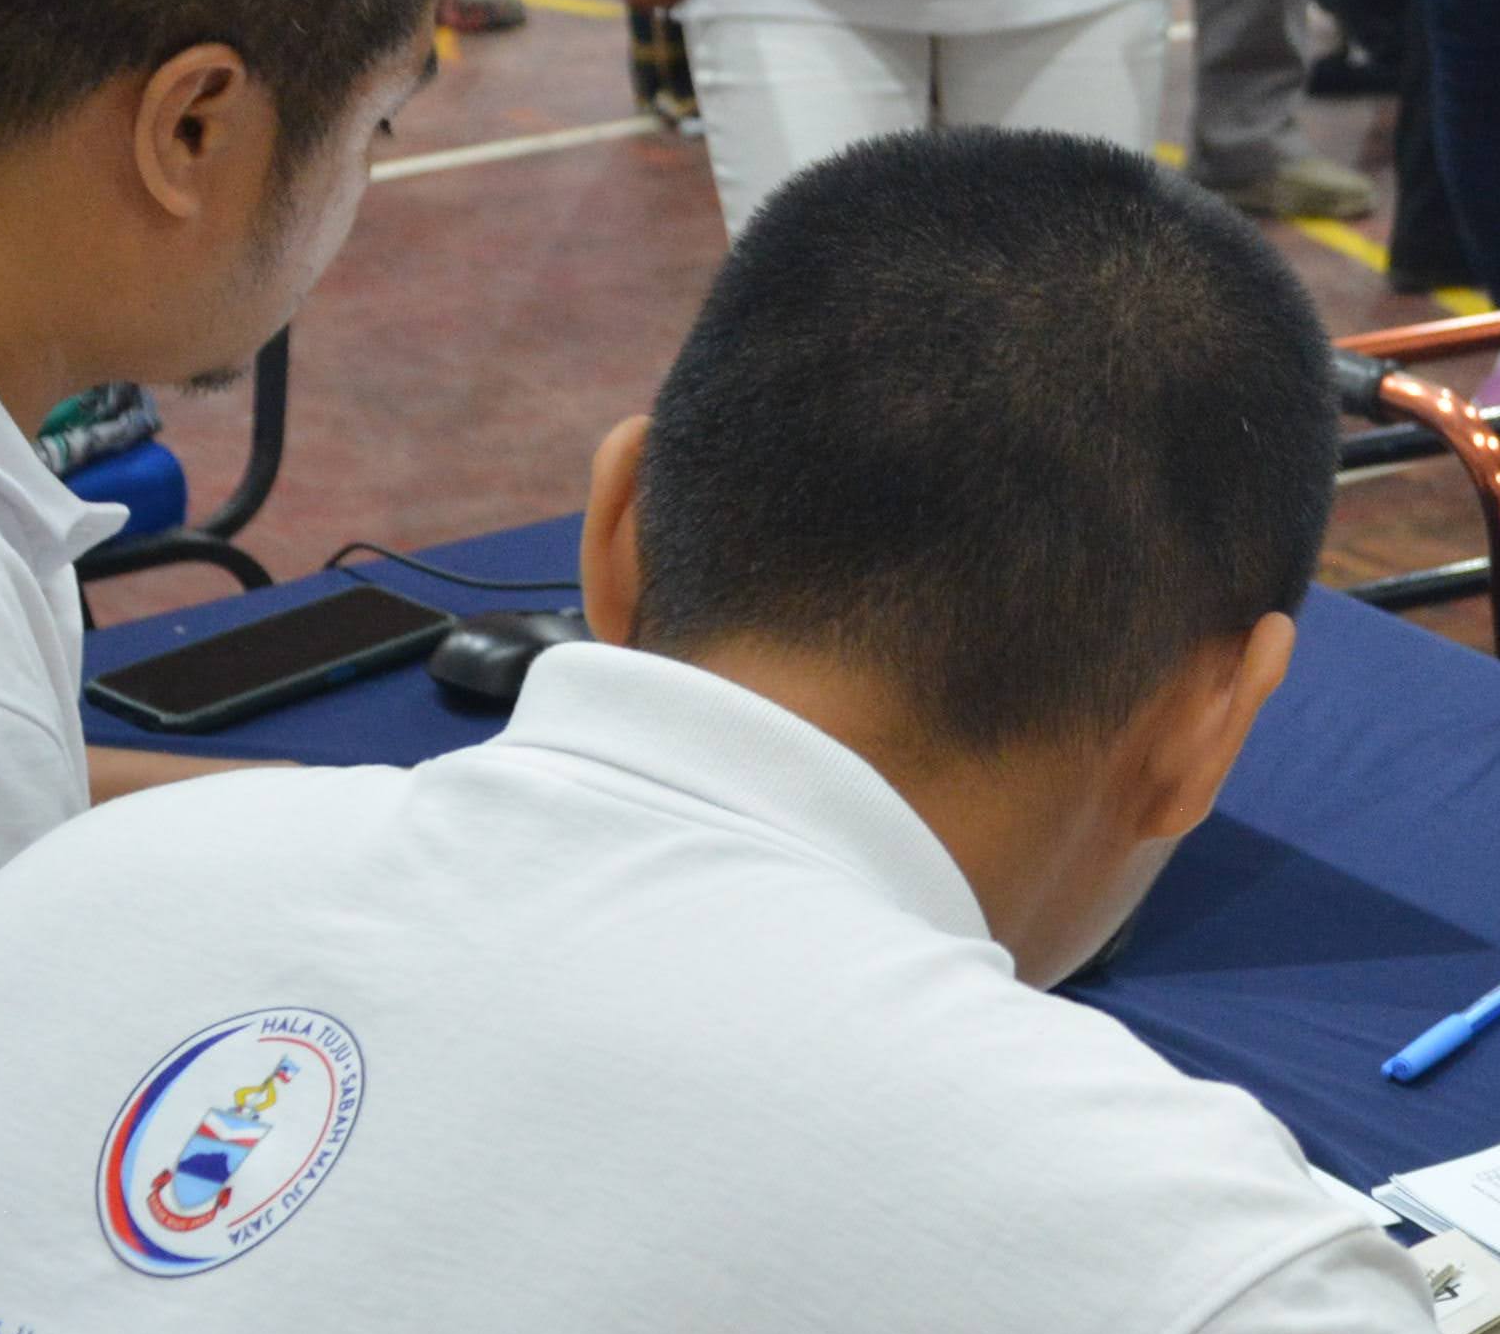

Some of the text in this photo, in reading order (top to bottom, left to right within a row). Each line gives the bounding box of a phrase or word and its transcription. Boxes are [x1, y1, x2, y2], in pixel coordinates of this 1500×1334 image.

[228, 1016, 359, 1247] HALA TUJU SABAH MAJU JAYA
